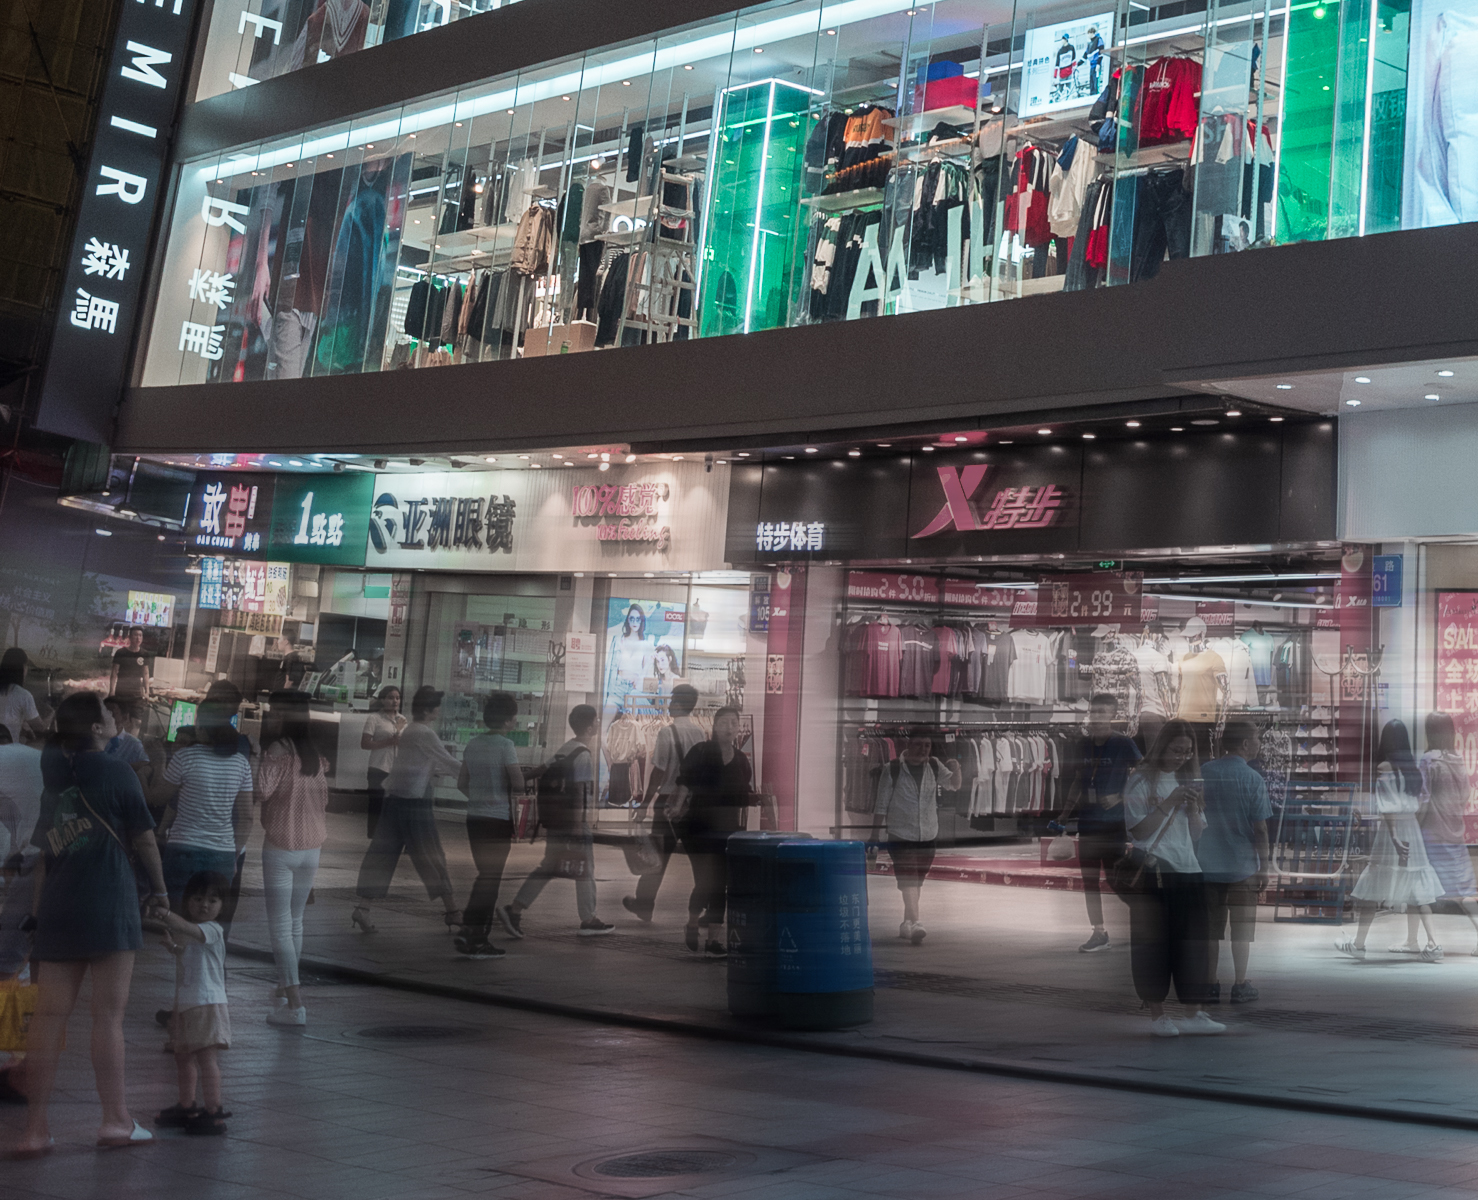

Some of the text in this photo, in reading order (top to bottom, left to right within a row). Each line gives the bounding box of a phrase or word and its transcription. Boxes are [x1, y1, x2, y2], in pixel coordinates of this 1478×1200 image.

[399, 493, 517, 554] 亚洲眼镜
[978, 484, 1062, 530] 特步
[756, 521, 824, 551] 特步体育
